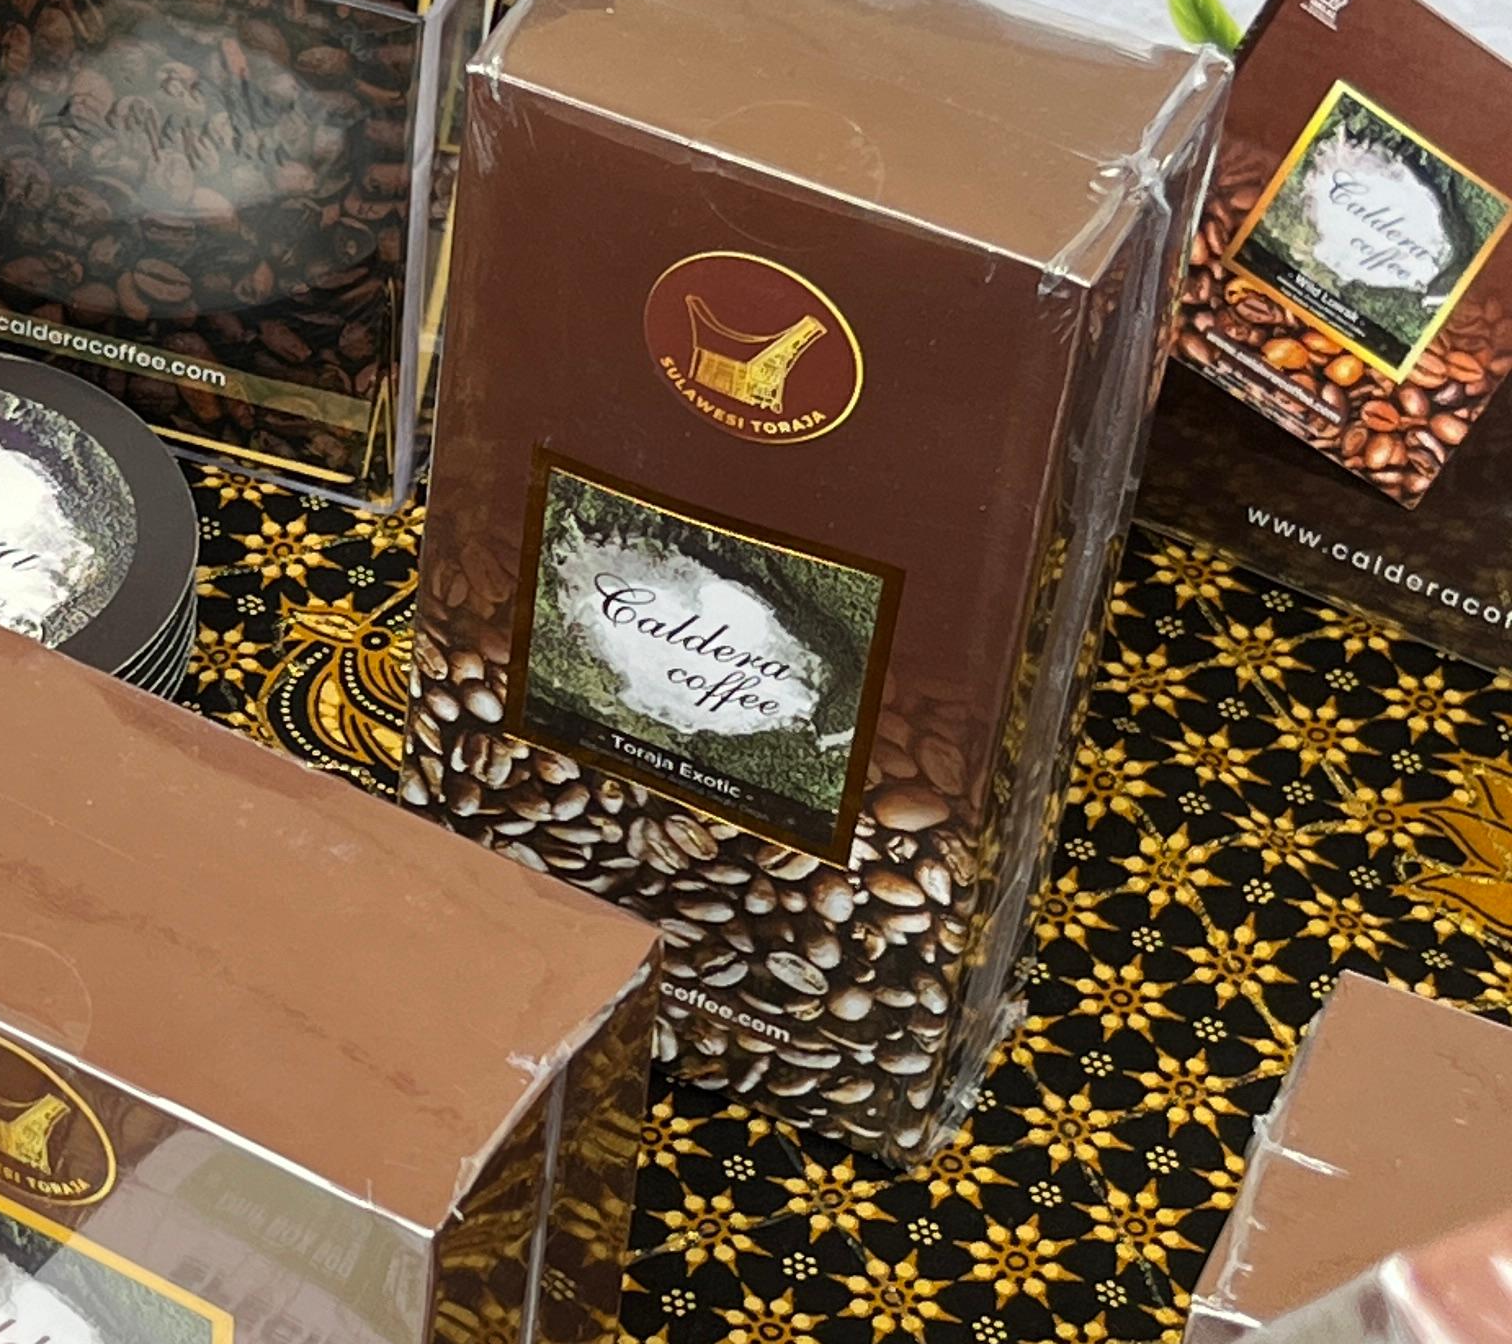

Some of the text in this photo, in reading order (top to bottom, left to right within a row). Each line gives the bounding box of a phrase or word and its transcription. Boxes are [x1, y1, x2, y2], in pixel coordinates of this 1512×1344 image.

[1329, 169, 1429, 259] Caldera
[1350, 236, 1410, 280] coffee
[660, 356, 827, 434] SULAWESI TORAJA
[595, 573, 791, 681] Caldera
[667, 670, 779, 716] coffee
[610, 734, 673, 771] Toraja
[680, 762, 741, 798] Exotic
